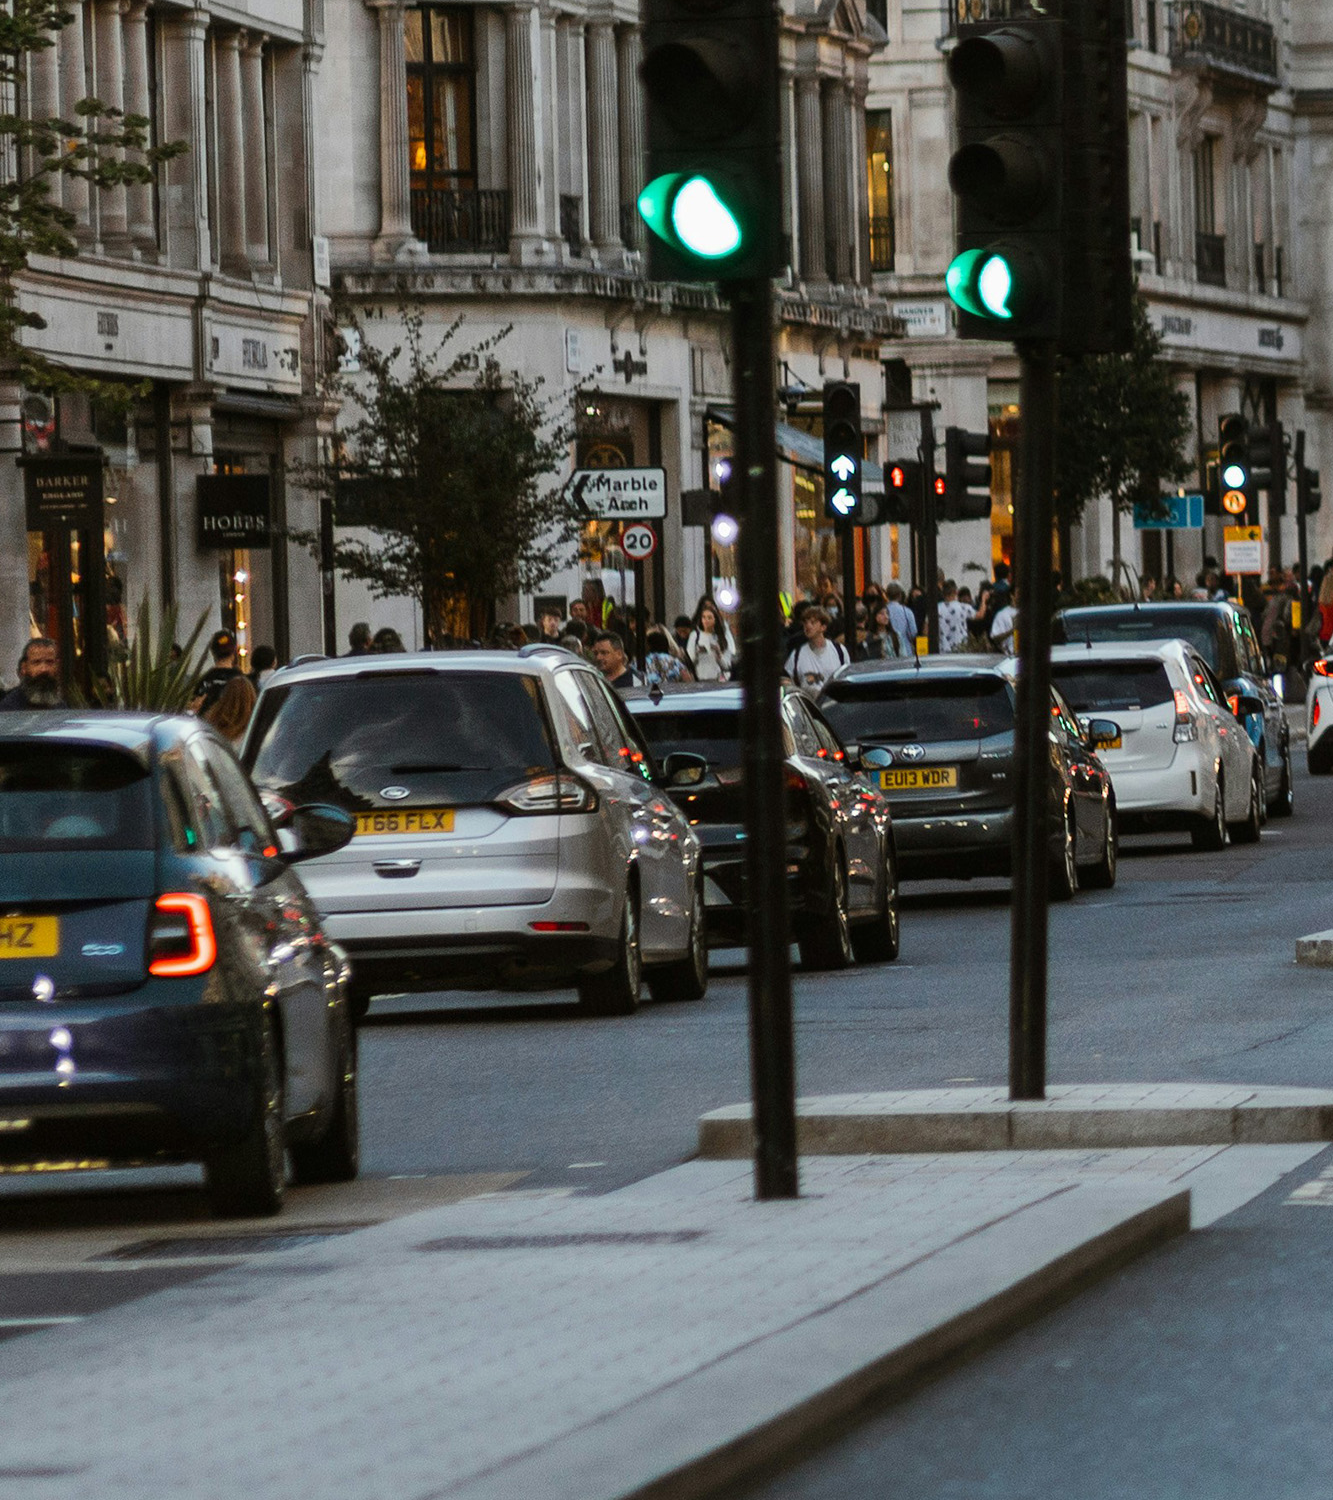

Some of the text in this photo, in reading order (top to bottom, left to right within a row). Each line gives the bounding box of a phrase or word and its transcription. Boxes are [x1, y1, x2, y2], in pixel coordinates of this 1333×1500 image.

[36, 475, 88, 488] BARKER
[596, 476, 658, 492] Marble
[607, 496, 649, 511] Arch
[203, 515, 265, 531] HOBBS
[626, 533, 652, 550] 20
[884, 768, 951, 786] EU13 WDR
[354, 811, 446, 832] T66 FLX
